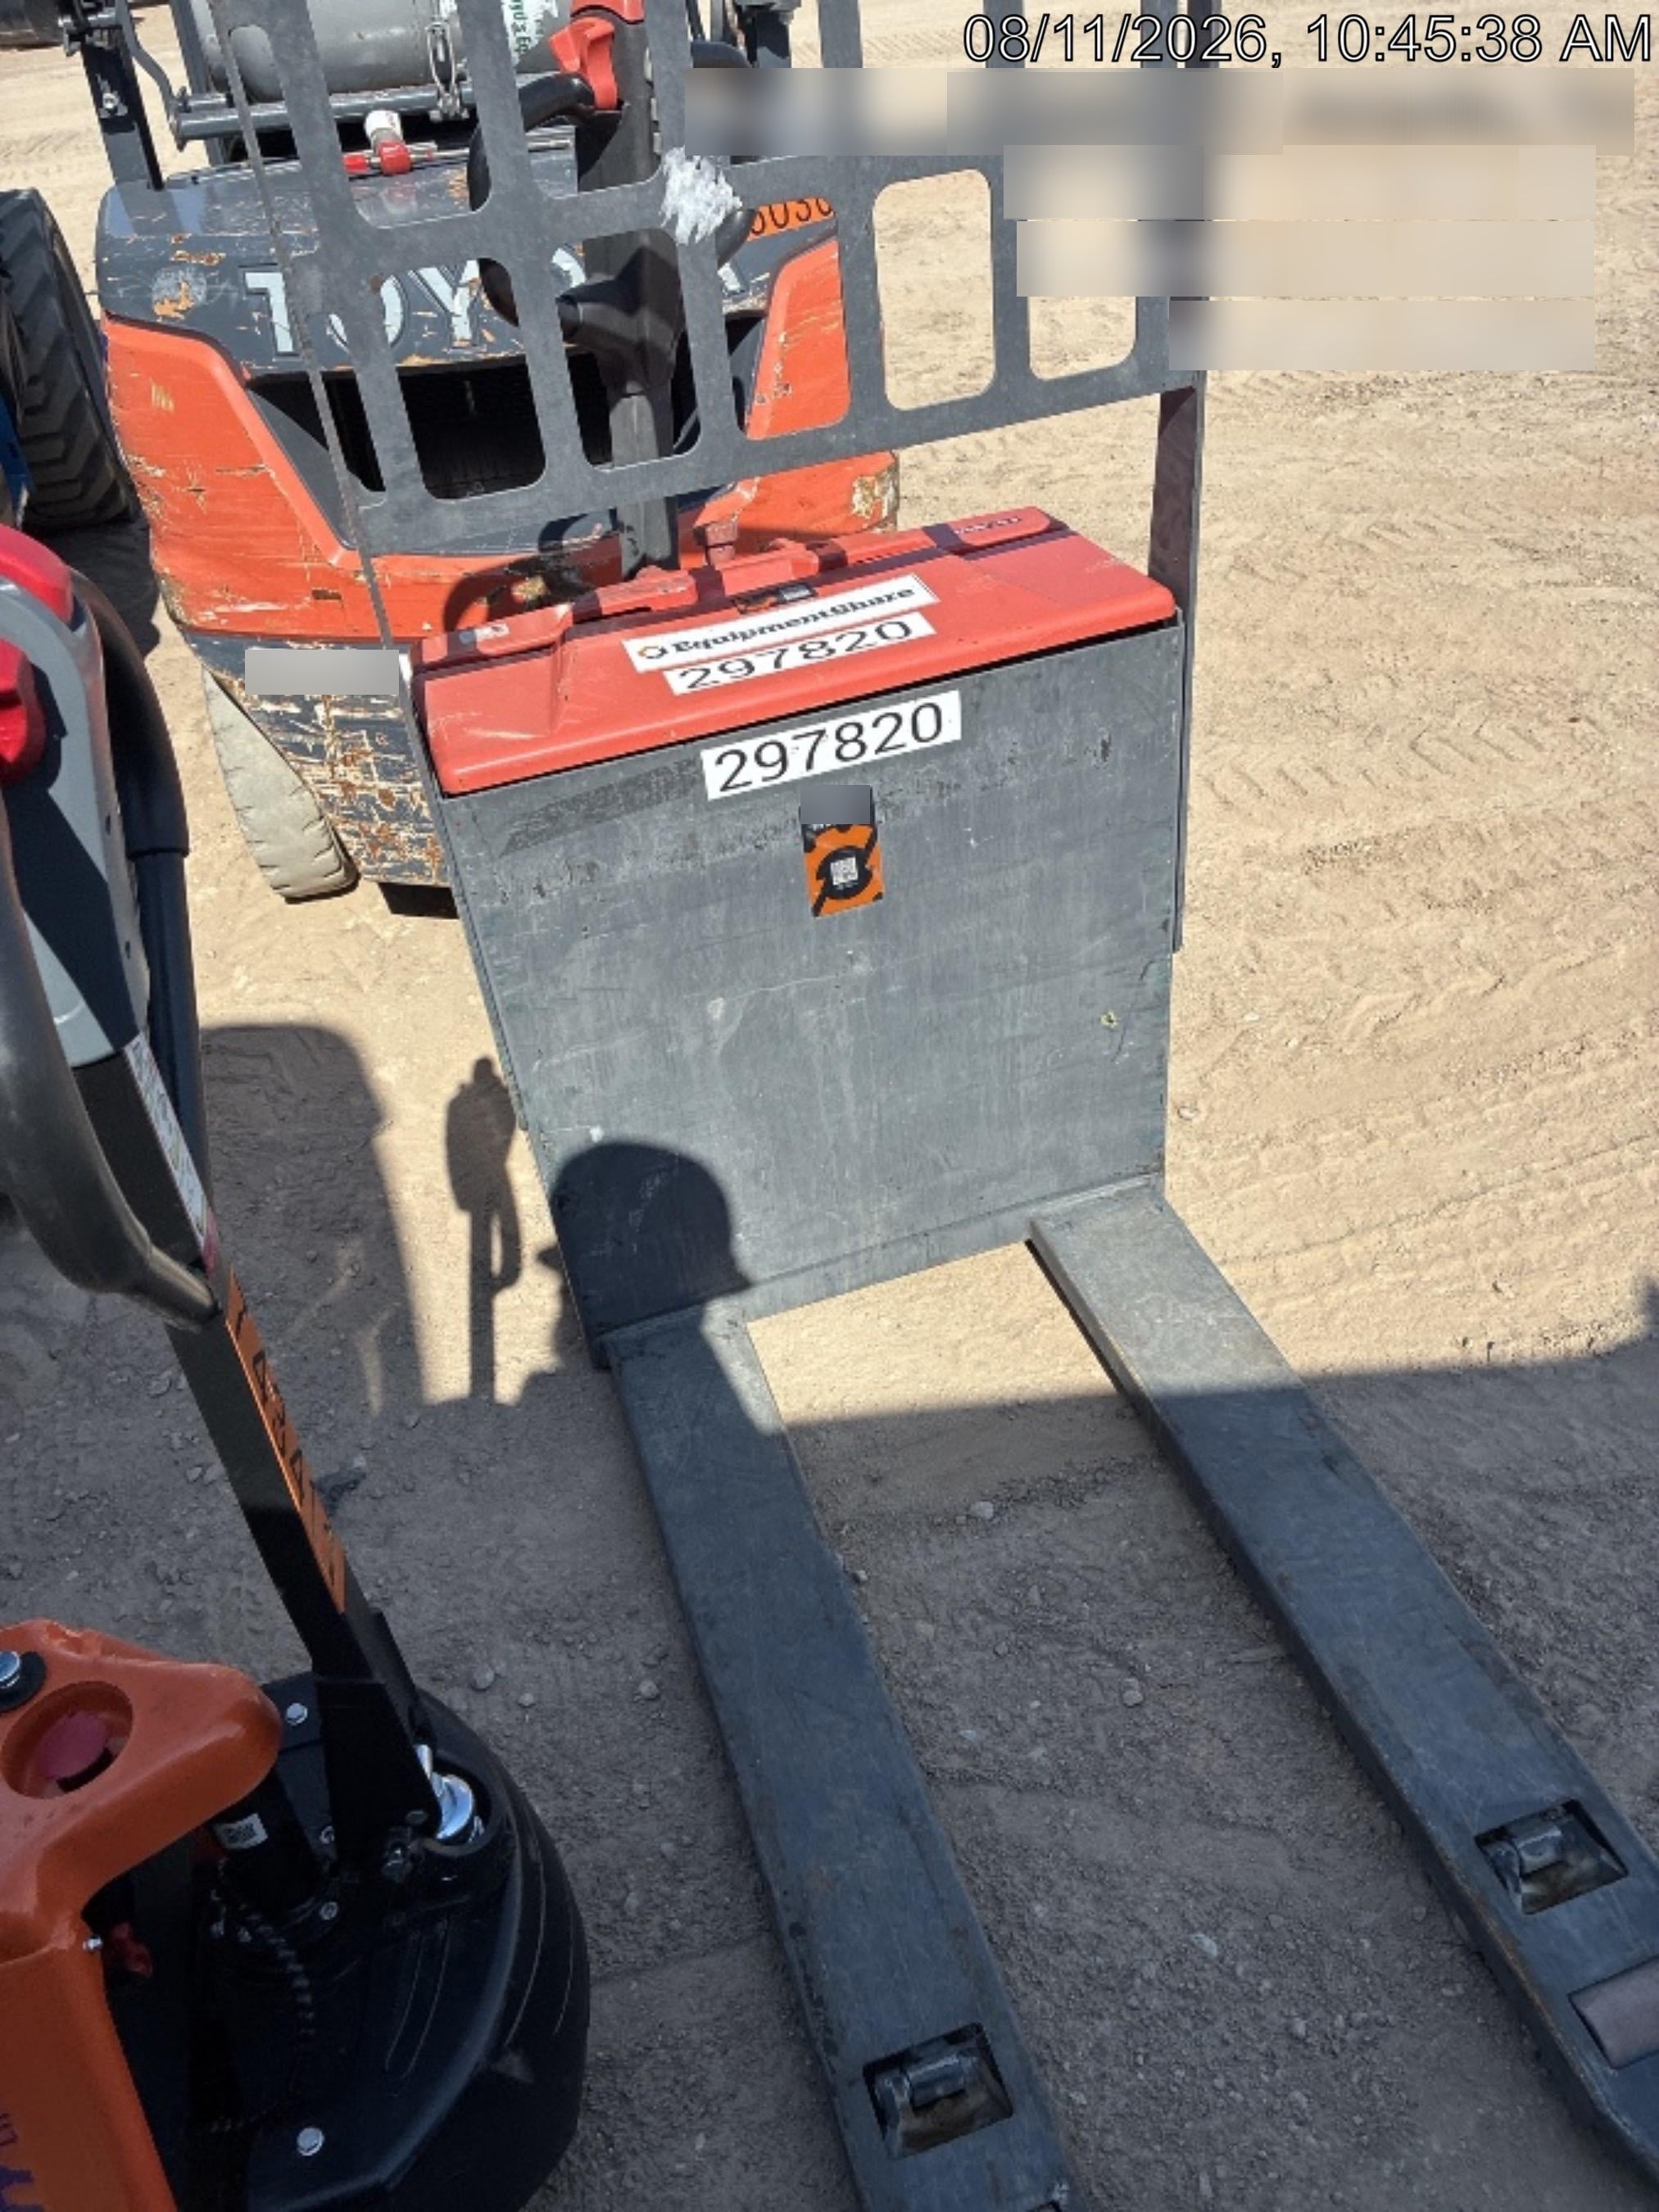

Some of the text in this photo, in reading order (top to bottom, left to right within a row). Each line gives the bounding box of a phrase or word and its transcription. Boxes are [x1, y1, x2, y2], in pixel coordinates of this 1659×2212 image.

[673, 587, 915, 653] EquipmentShare
[681, 621, 912, 689] 297820
[714, 702, 942, 792] 297820
